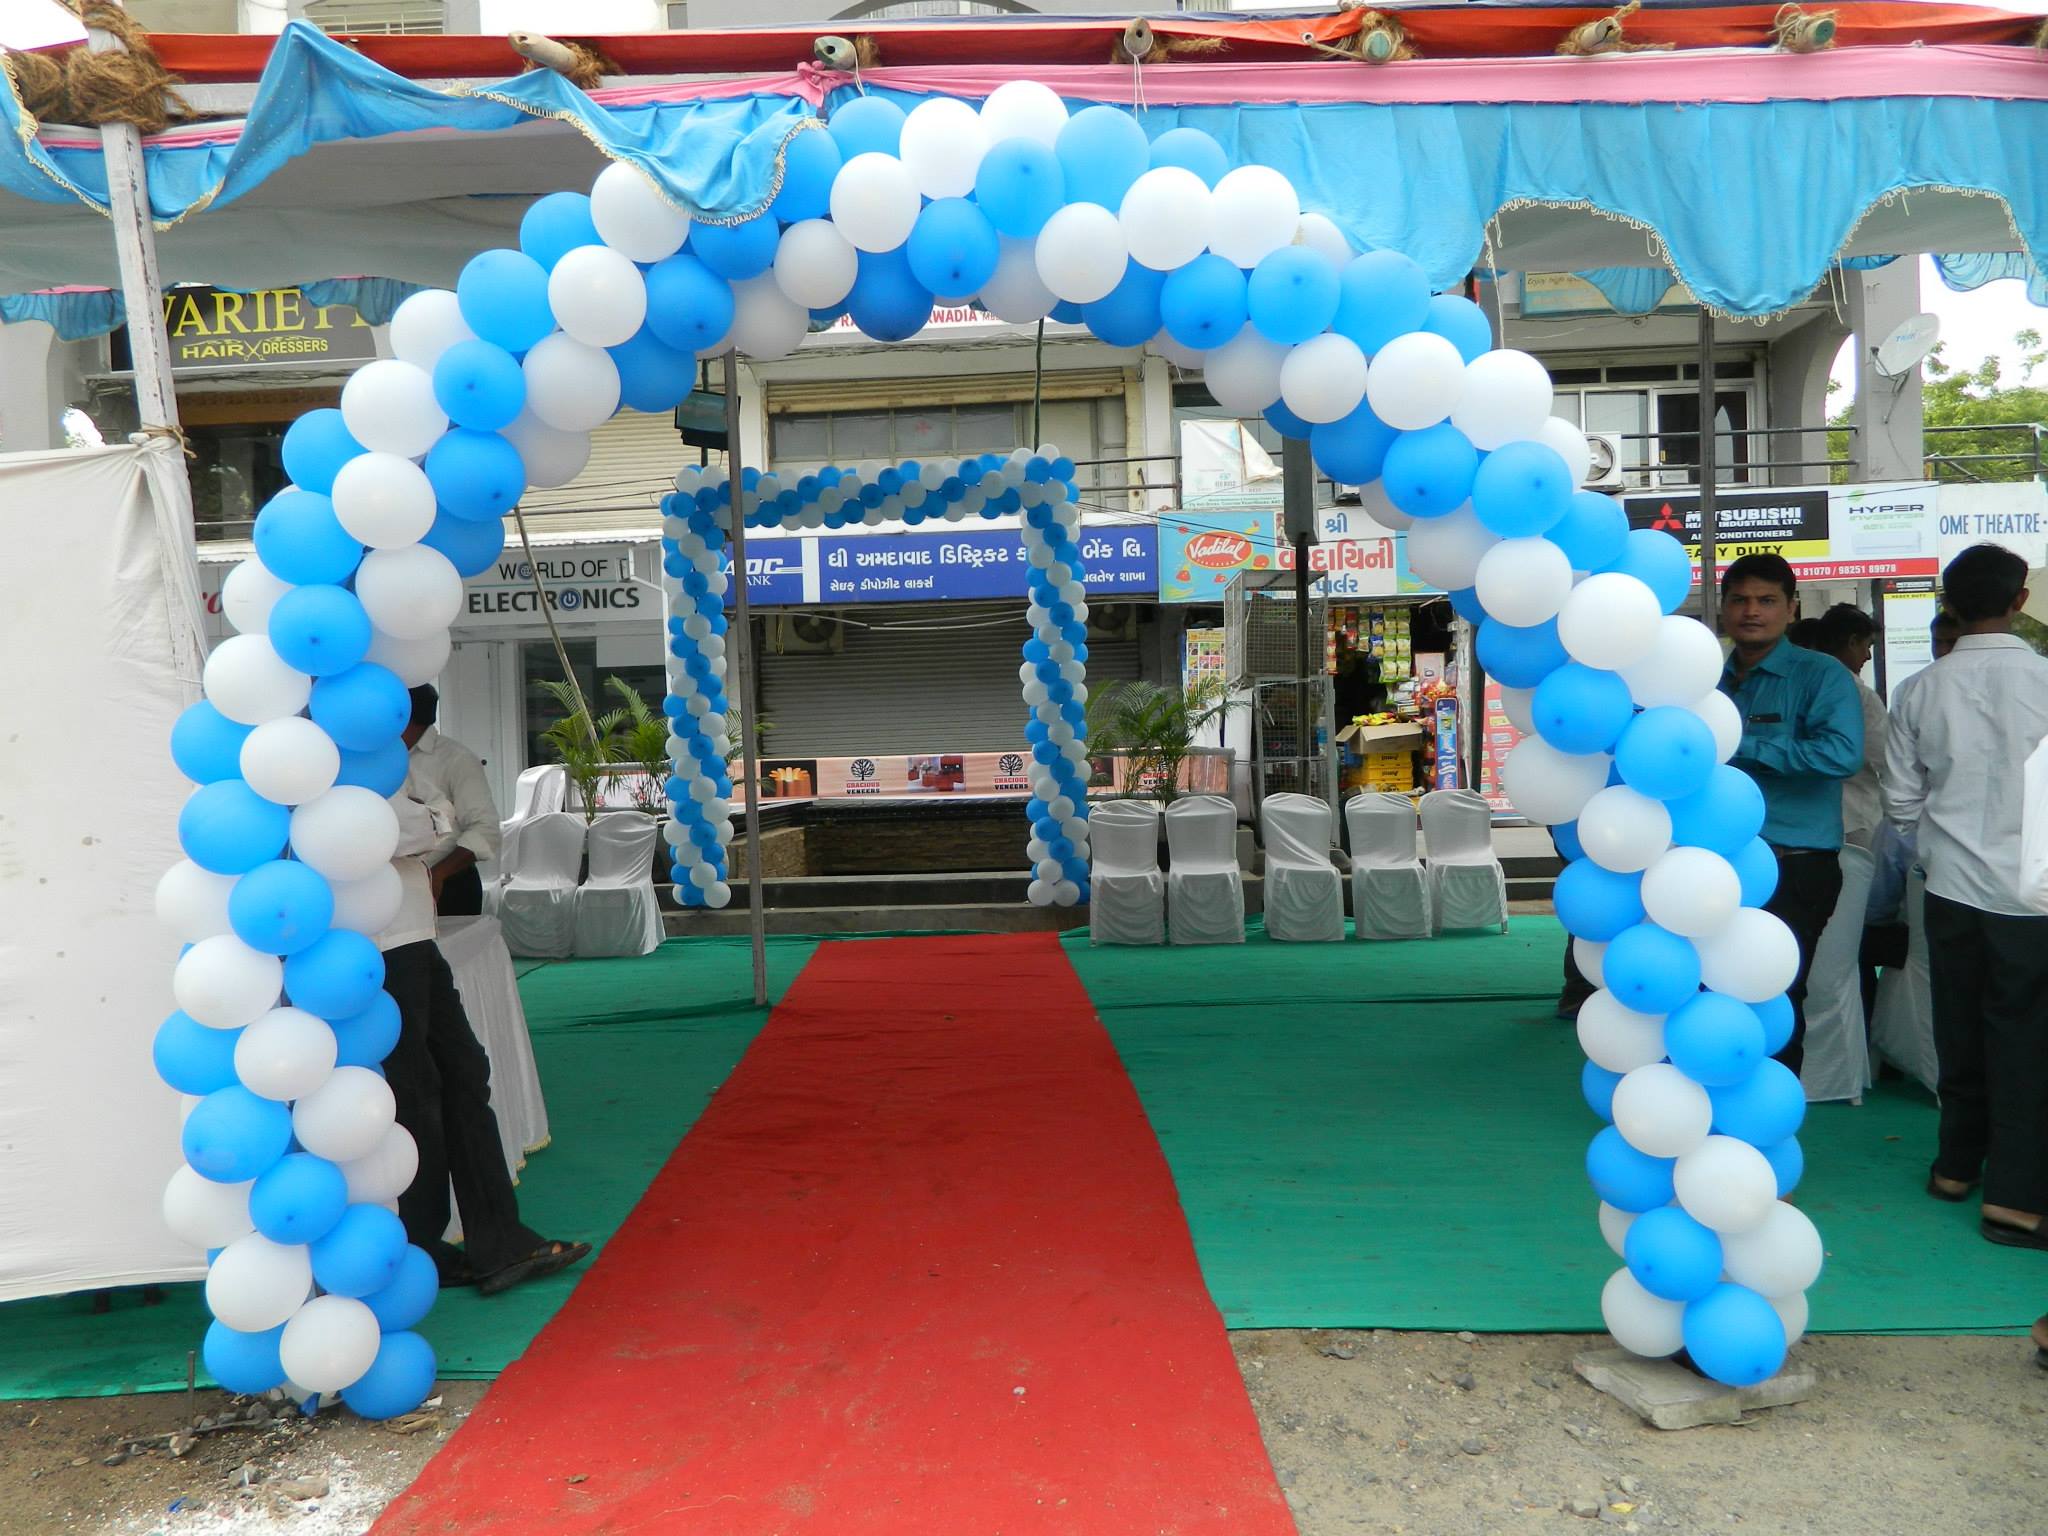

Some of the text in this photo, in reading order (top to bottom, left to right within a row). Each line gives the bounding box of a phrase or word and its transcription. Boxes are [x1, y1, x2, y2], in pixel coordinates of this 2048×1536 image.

[930, 309, 977, 324] WADIA
[183, 339, 329, 360] HAIR DRESSERS
[1685, 507, 1801, 523] MSUBISHI
[1849, 504, 1925, 514] HYPER
[1325, 512, 1348, 533] શ્રી
[1939, 512, 2041, 536] OME THEATRE
[856, 550, 933, 567] અમદાવાદ
[1122, 537, 1147, 558] લિ.
[1189, 535, 1246, 561] Vadilal
[1278, 536, 1394, 572] વદાયિની
[1736, 545, 1784, 557] DUTY
[581, 559, 608, 578] OF
[1119, 571, 1146, 582] શાખા
[745, 575, 773, 586] ANK
[468, 587, 640, 614] ELECTRONICS
